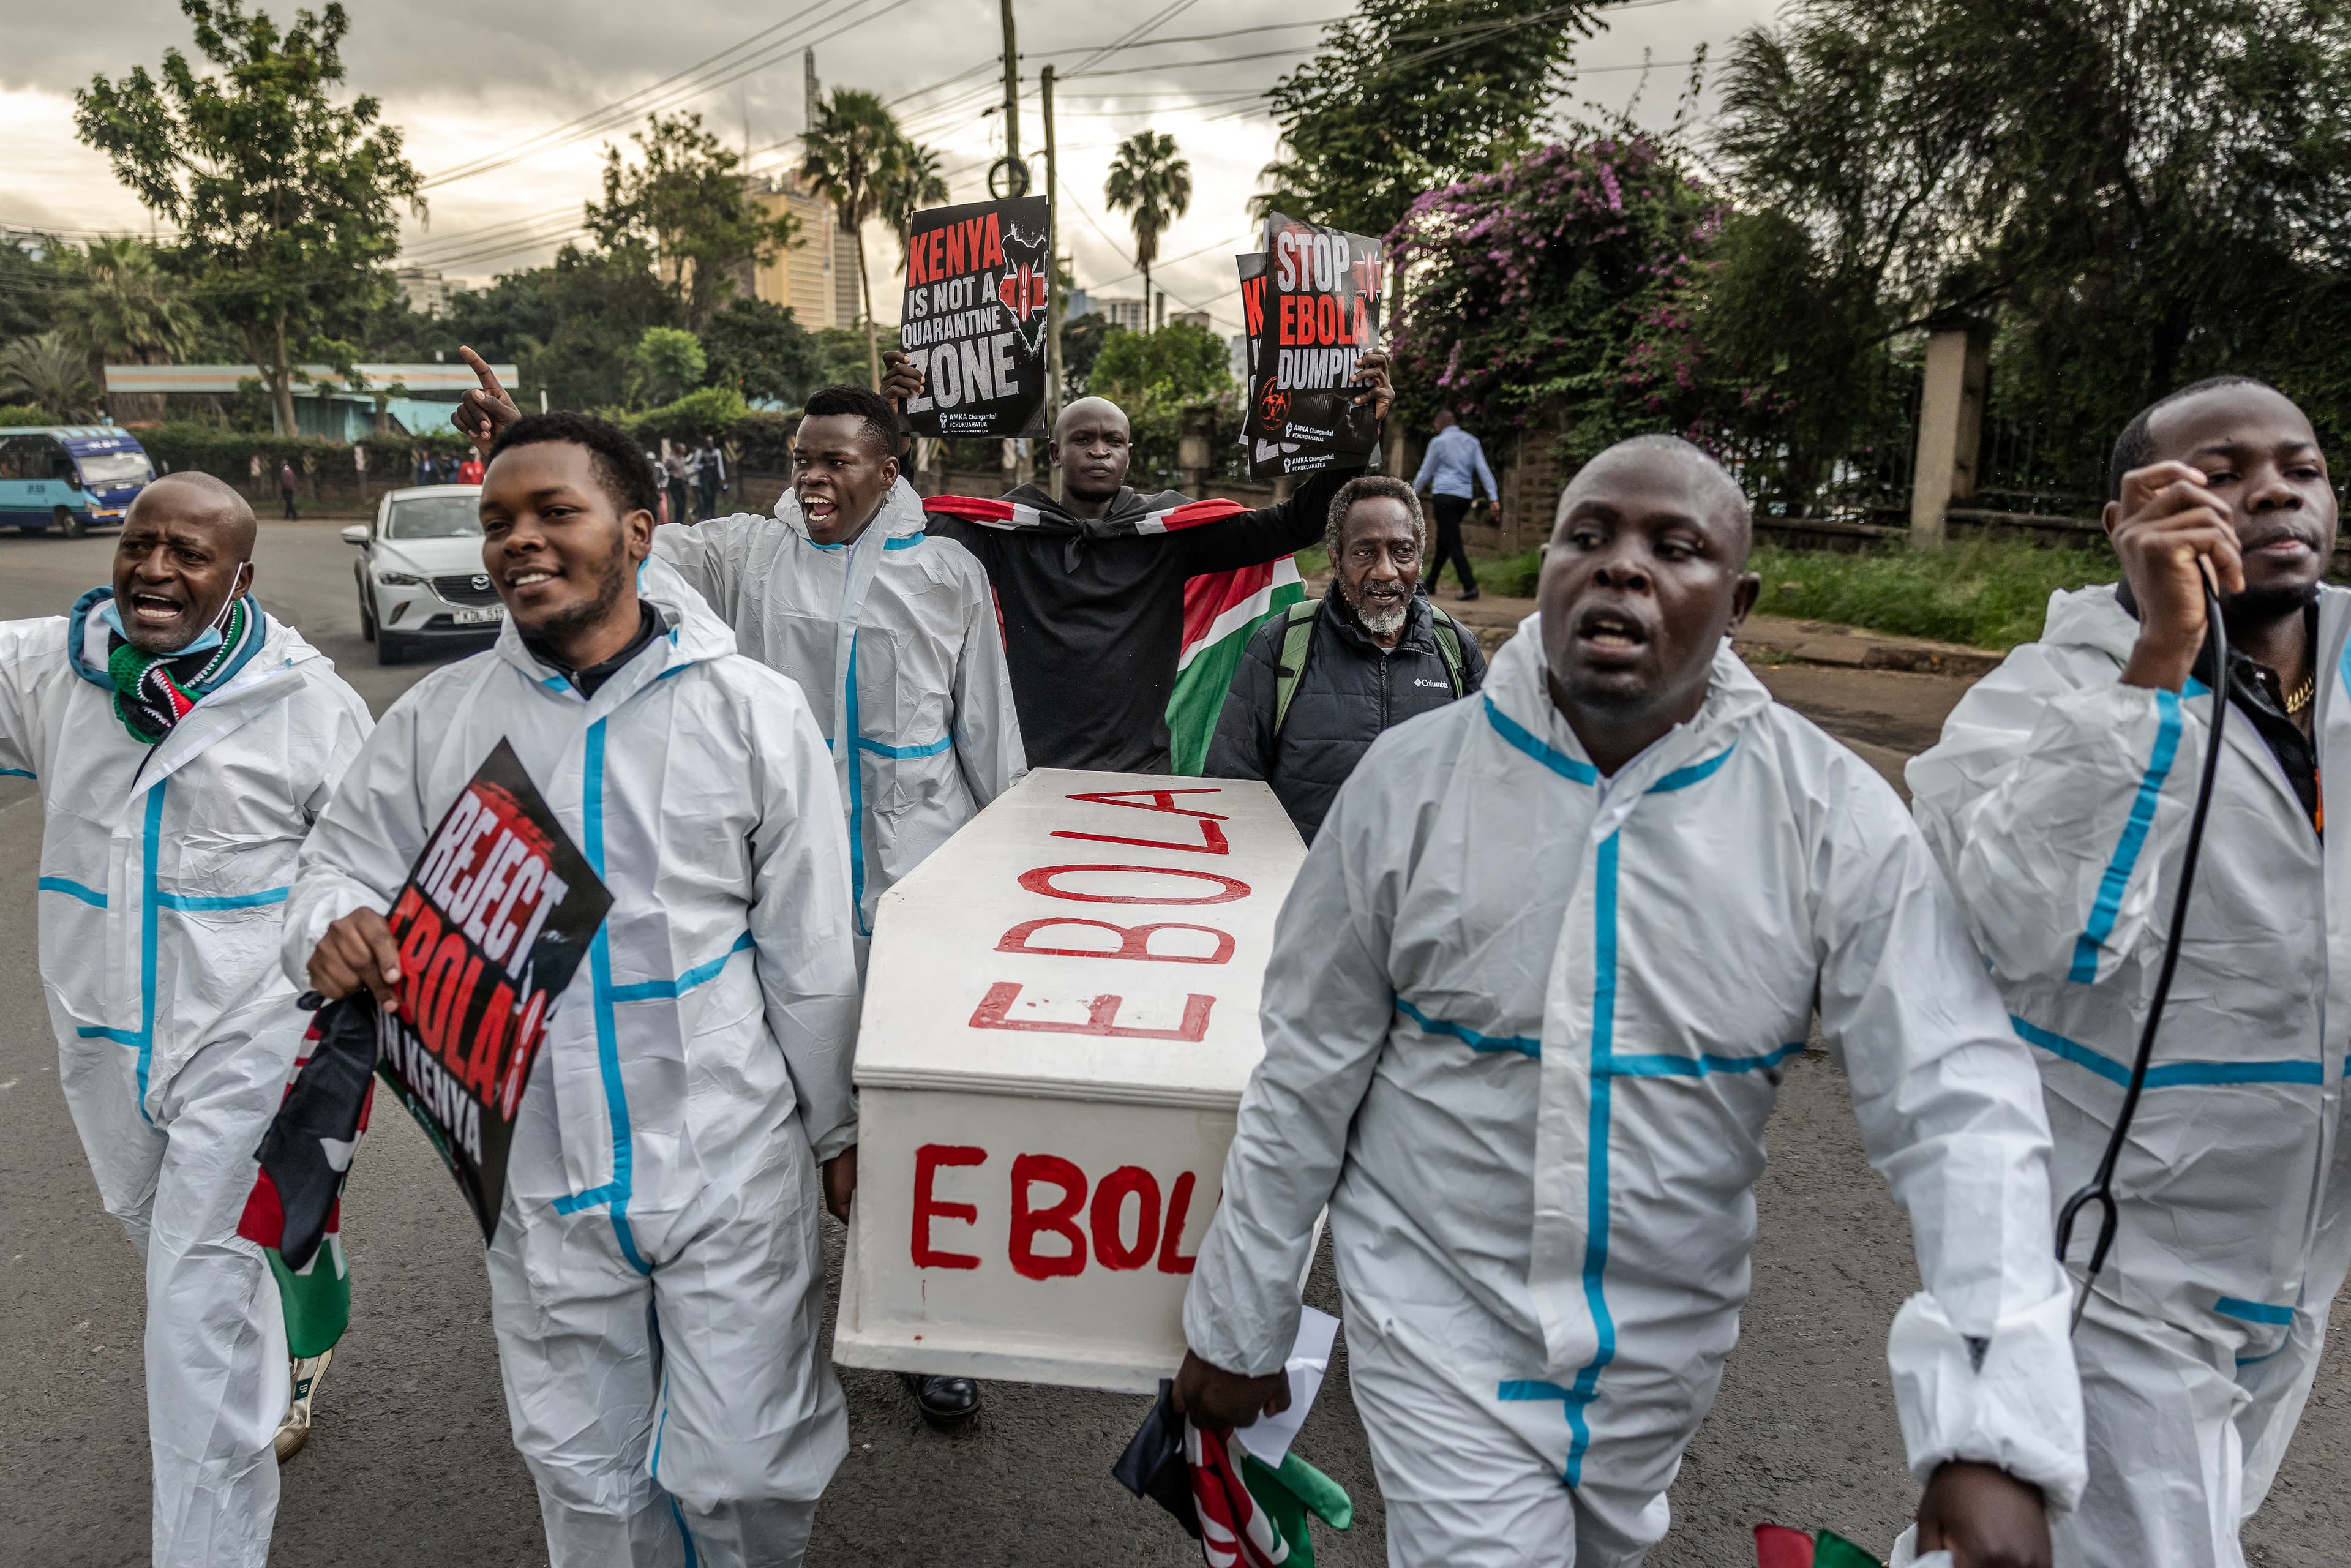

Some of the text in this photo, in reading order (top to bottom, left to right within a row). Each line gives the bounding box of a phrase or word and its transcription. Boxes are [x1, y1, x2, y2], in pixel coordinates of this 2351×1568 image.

[909, 212, 1003, 288] KENYA
[1277, 231, 1350, 292] STOP
[909, 271, 997, 320] IS NOT A
[1280, 294, 1370, 345] EBOLA
[902, 305, 1002, 351] QUARANTINE
[906, 332, 1019, 415] ZONE
[968, 413, 997, 421] Changamka!
[1292, 433, 1324, 442] #CHUKUAHATUA
[1293, 424, 1334, 437] AMKA Changamka!
[1292, 453, 1335, 465] AMKA Changamka!
[1292, 463, 1326, 471] #CHUKUAHATUA
[1421, 679, 1449, 688] Columbia
[416, 789, 569, 980] REJECT
[969, 787, 1251, 1042] EBOLA
[375, 1011, 482, 1166] IN KENYA
[911, 1142, 1223, 1281] EBOL
